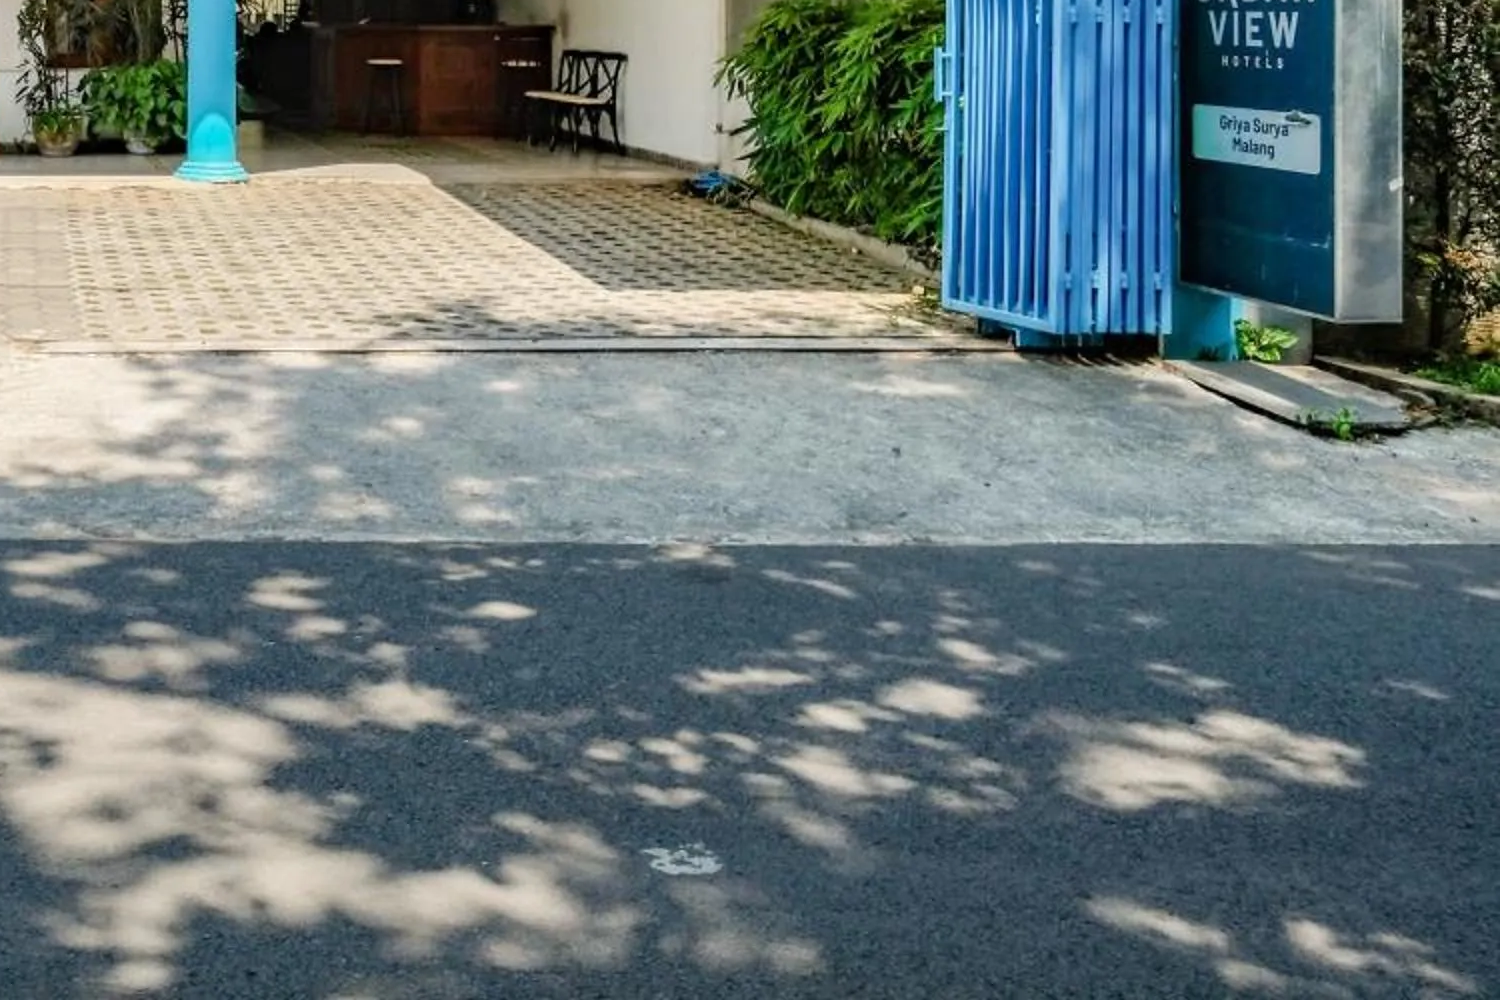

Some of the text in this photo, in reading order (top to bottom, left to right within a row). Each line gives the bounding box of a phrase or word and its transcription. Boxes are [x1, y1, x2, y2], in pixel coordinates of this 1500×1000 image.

[1208, 10, 1299, 49] VIEW
[1221, 54, 1284, 70] HOTELS
[1219, 114, 1289, 138] Griya Surya
[1232, 137, 1275, 159] Malang
